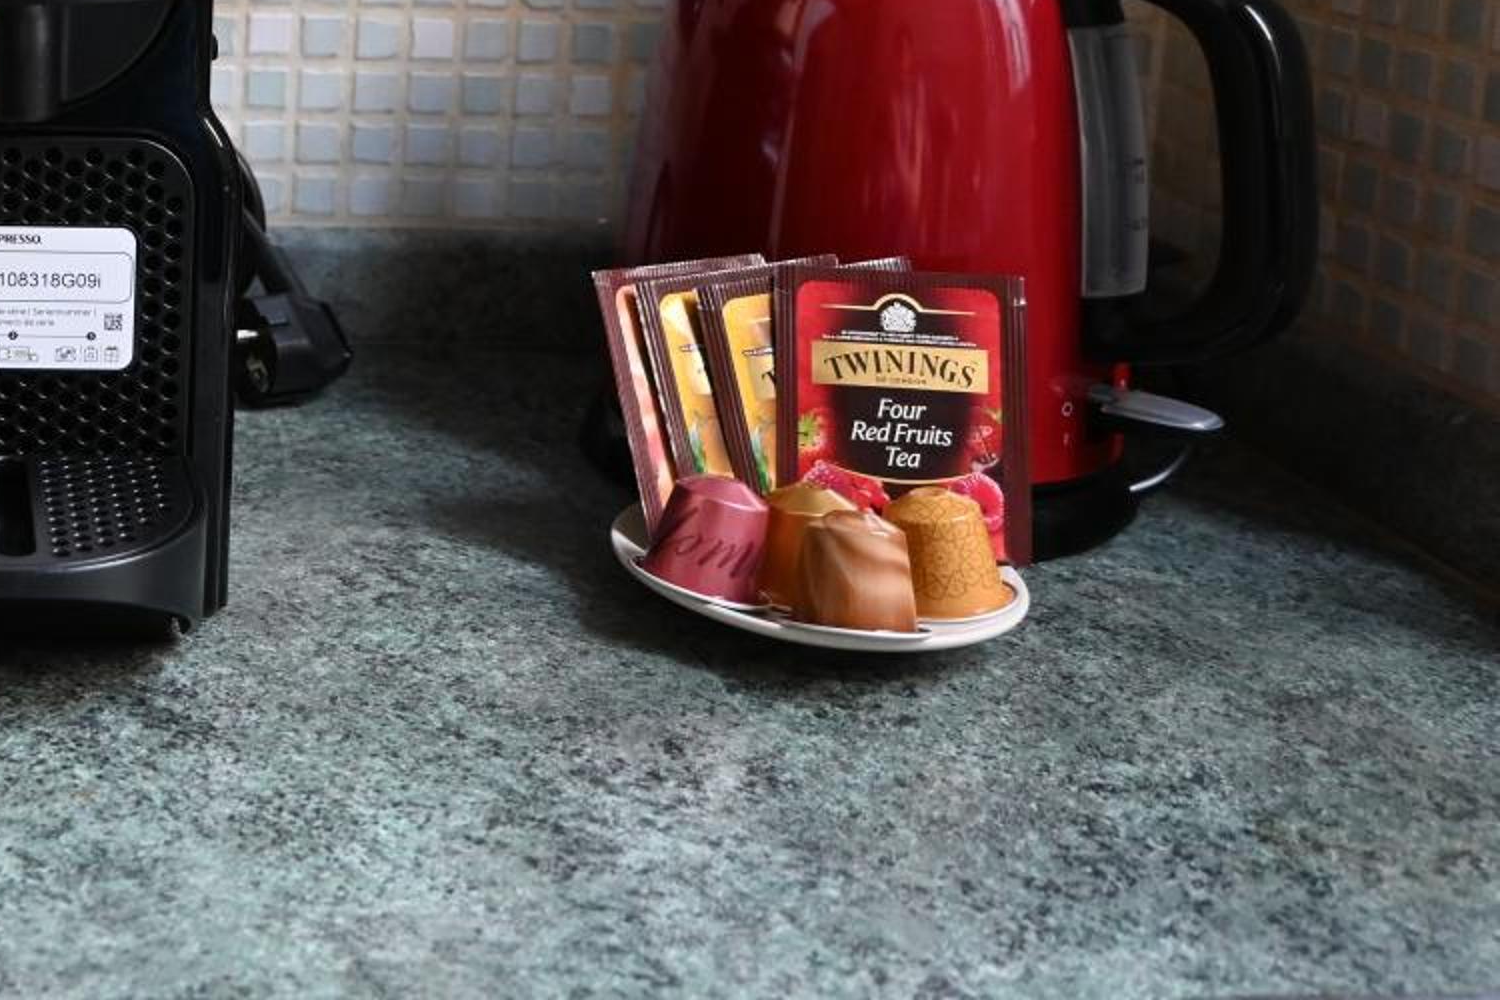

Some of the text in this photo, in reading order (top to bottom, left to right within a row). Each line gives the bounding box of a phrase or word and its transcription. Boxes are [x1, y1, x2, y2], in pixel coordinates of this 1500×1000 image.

[823, 350, 975, 388] TWININGS
[877, 398, 927, 420] Four
[851, 420, 953, 446] Red Fruits
[885, 446, 921, 468] Tea
